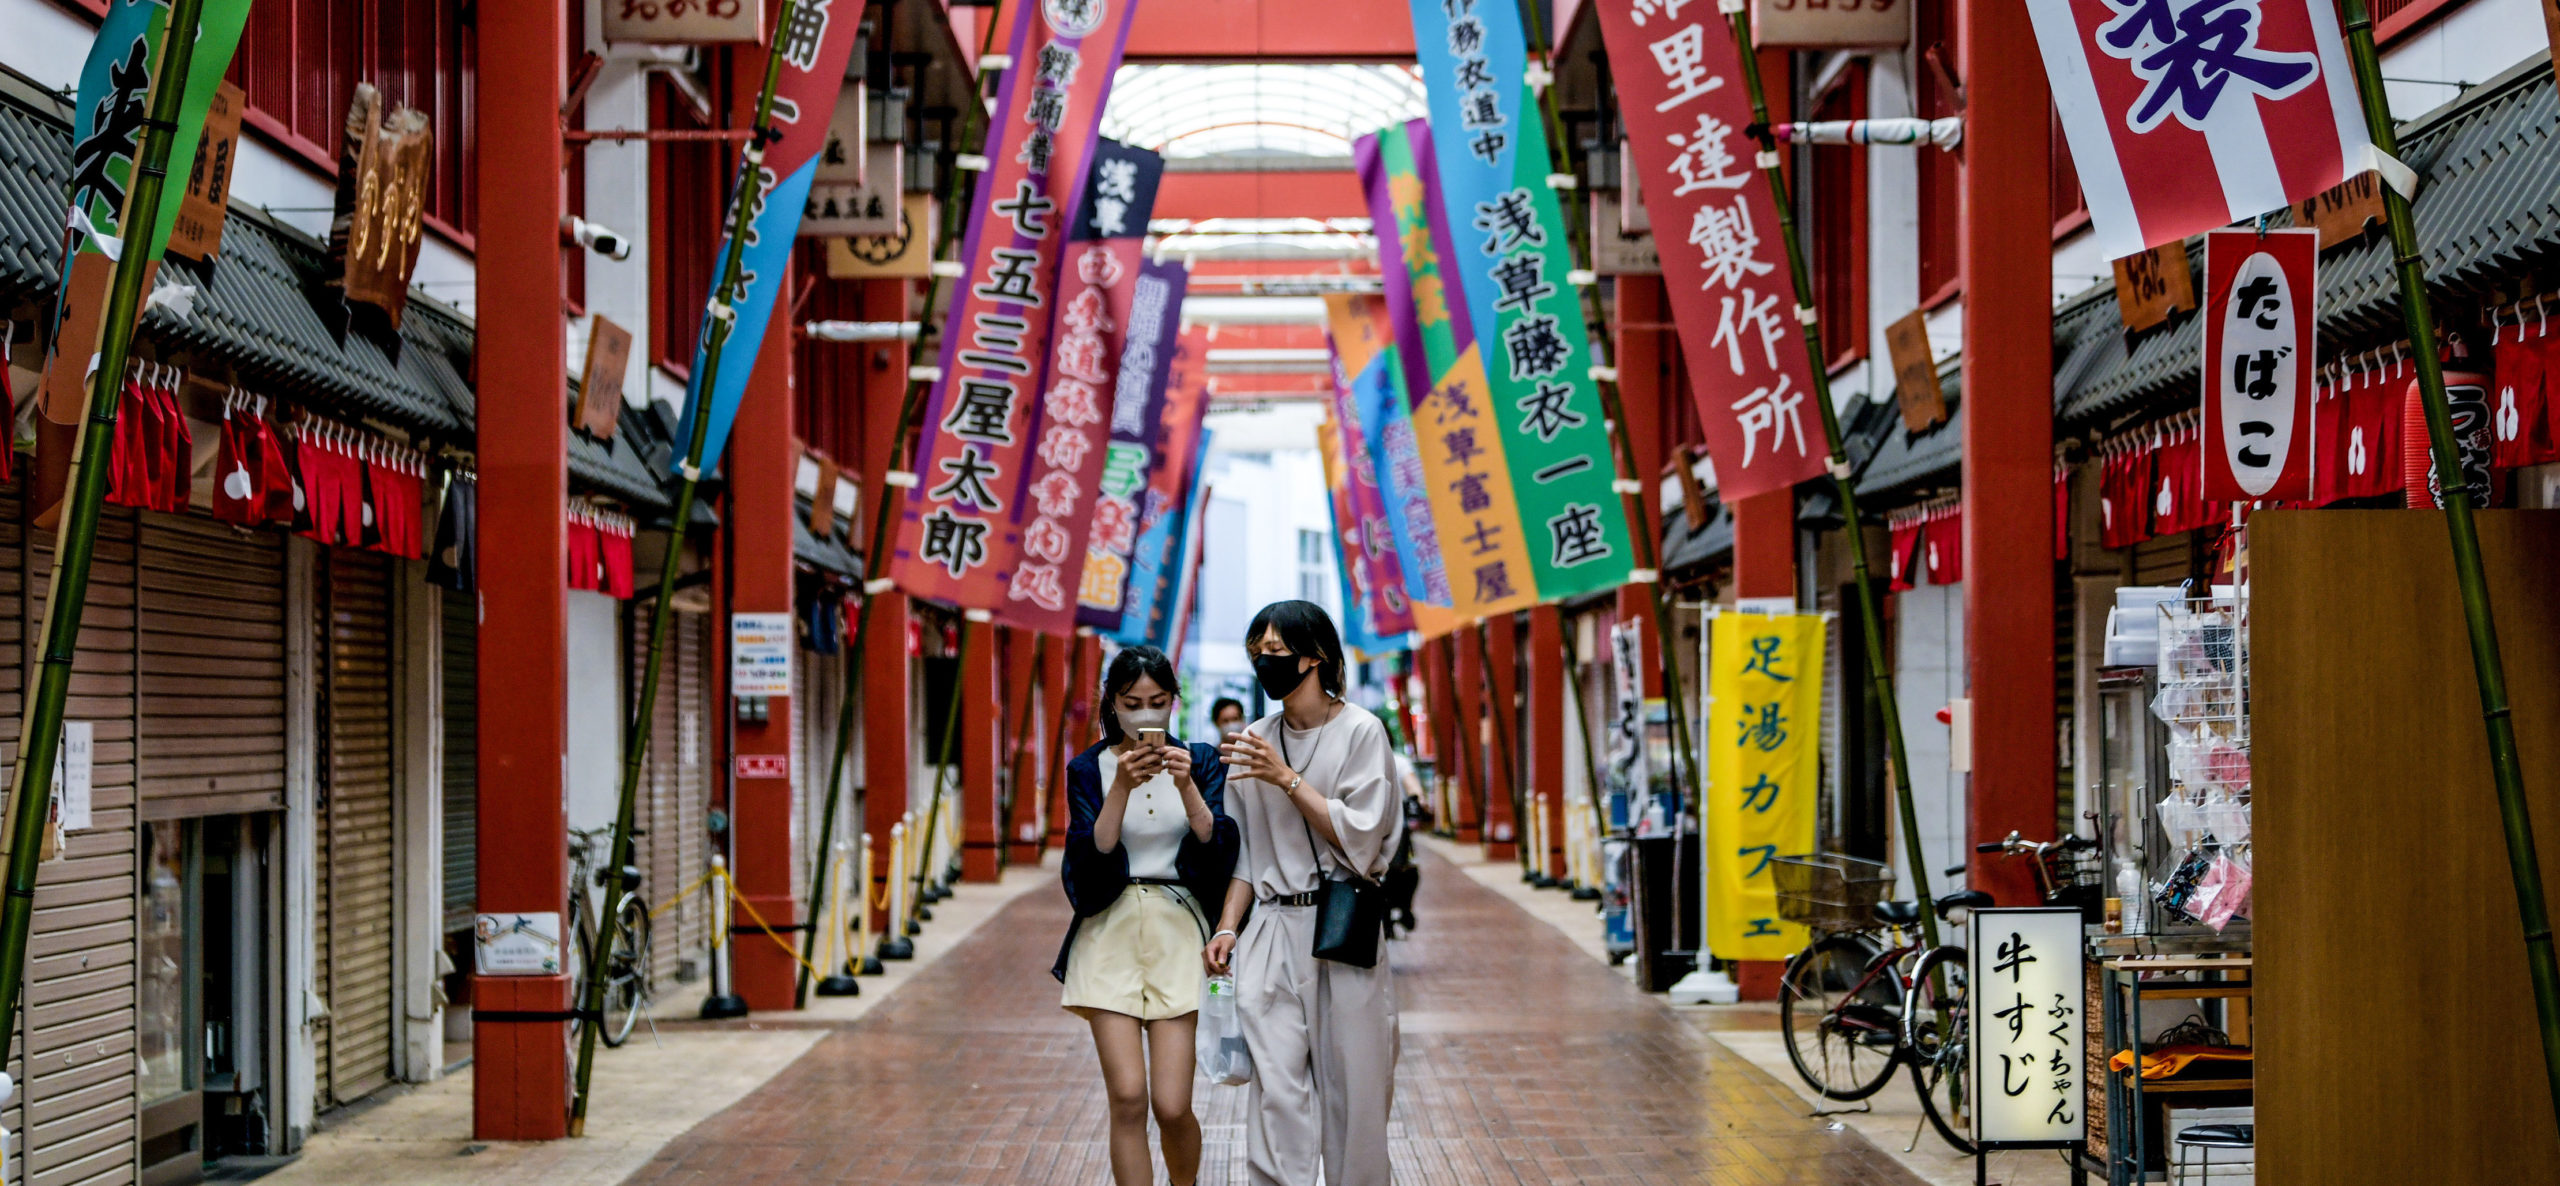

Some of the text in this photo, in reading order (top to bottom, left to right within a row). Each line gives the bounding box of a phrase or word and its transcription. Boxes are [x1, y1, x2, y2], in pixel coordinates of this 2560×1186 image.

[2234, 276, 2291, 468] たばこ
[1736, 635, 1794, 937] 足湯カフェ
[1993, 932, 2037, 1097] 牛すじ
[2047, 993, 2075, 1126] ふくちゃん
